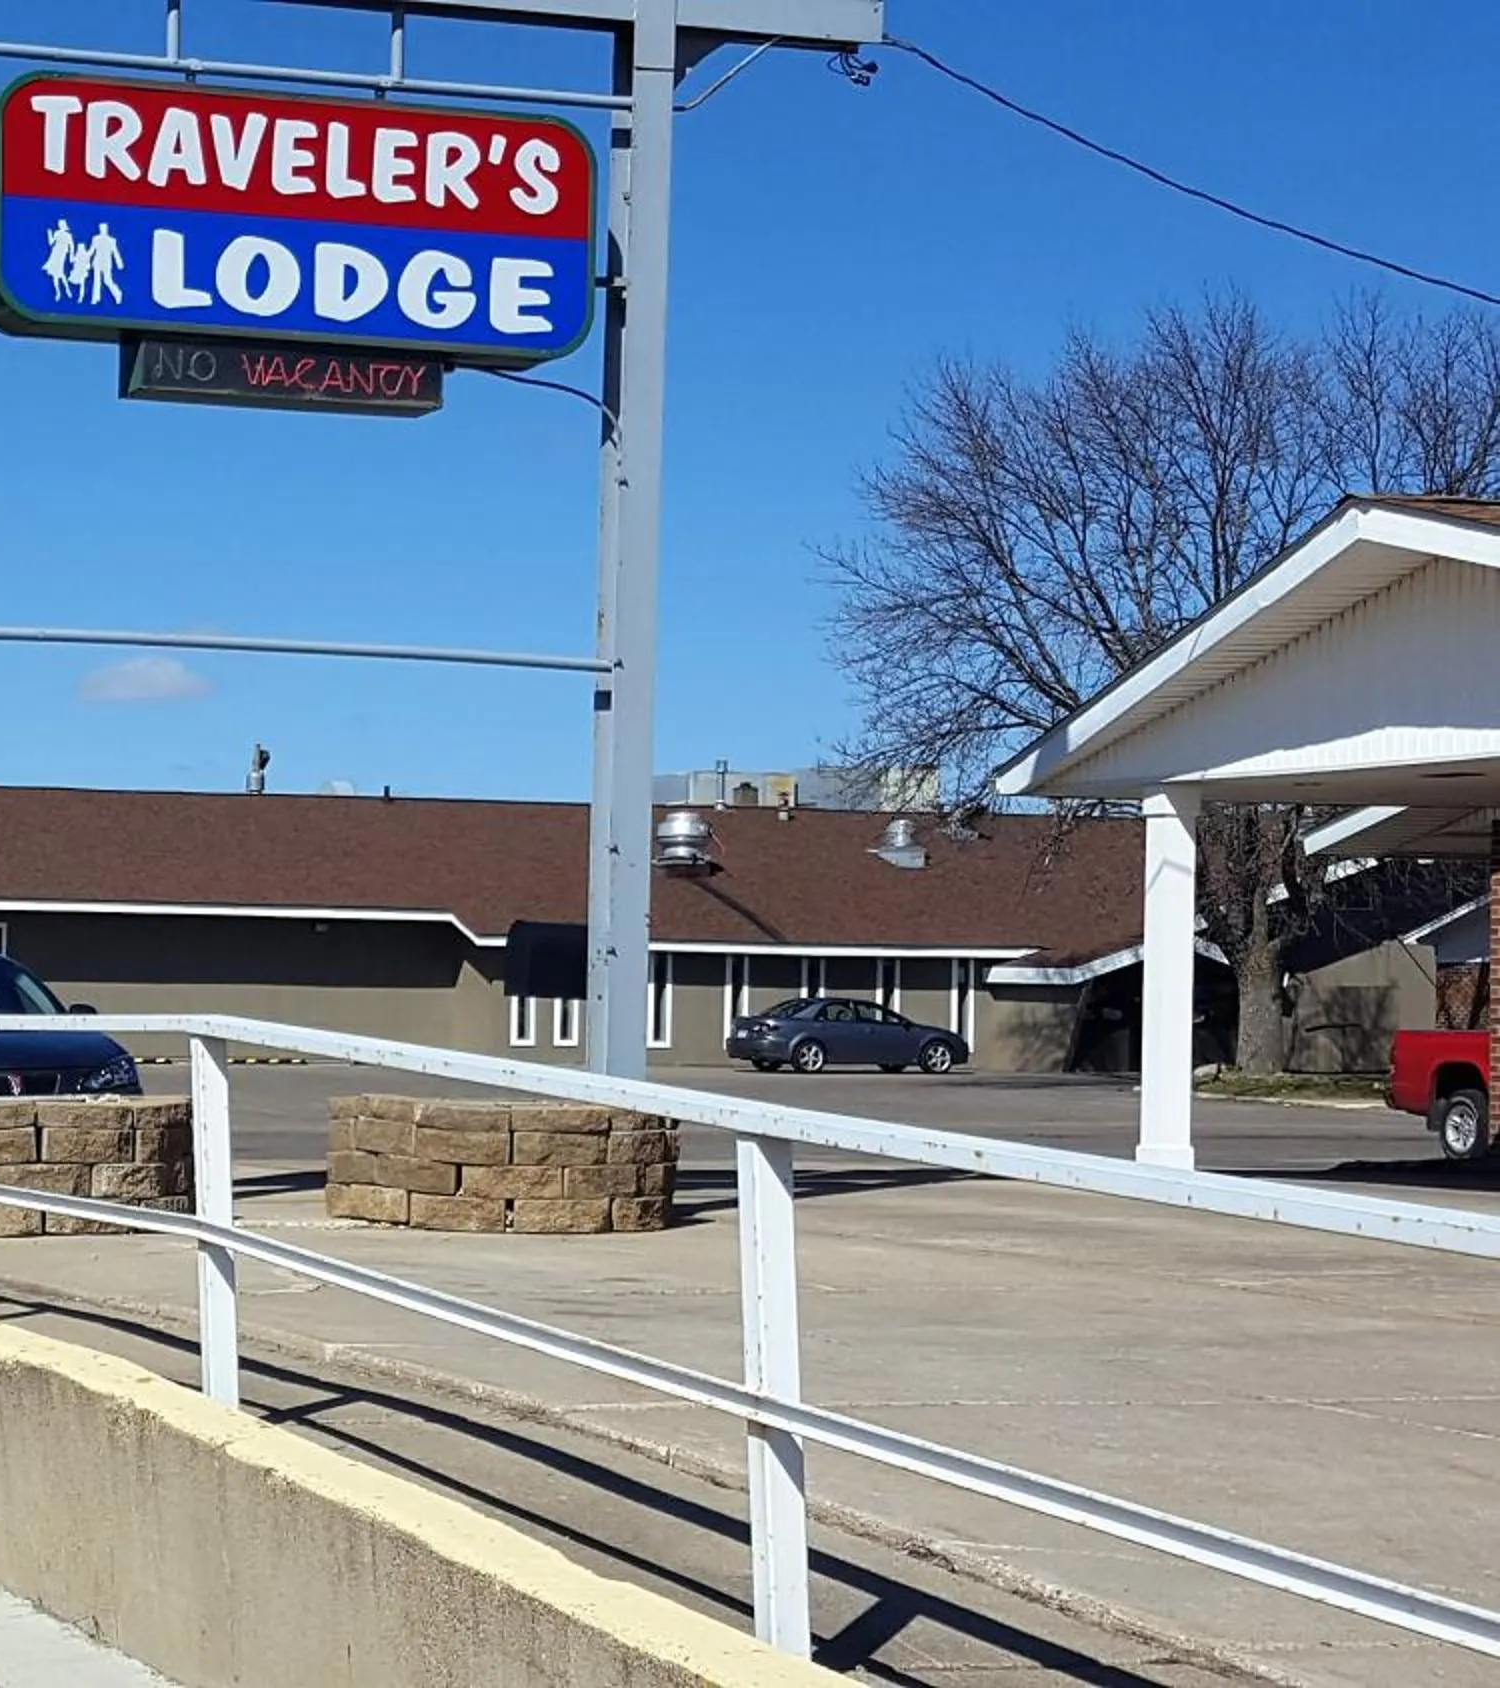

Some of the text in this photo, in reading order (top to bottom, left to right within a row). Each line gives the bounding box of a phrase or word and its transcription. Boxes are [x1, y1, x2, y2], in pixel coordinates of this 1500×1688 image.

[31, 95, 560, 215] TRAVELER'S
[152, 229, 555, 333] LODGE
[155, 347, 426, 398] NO VACANCY
